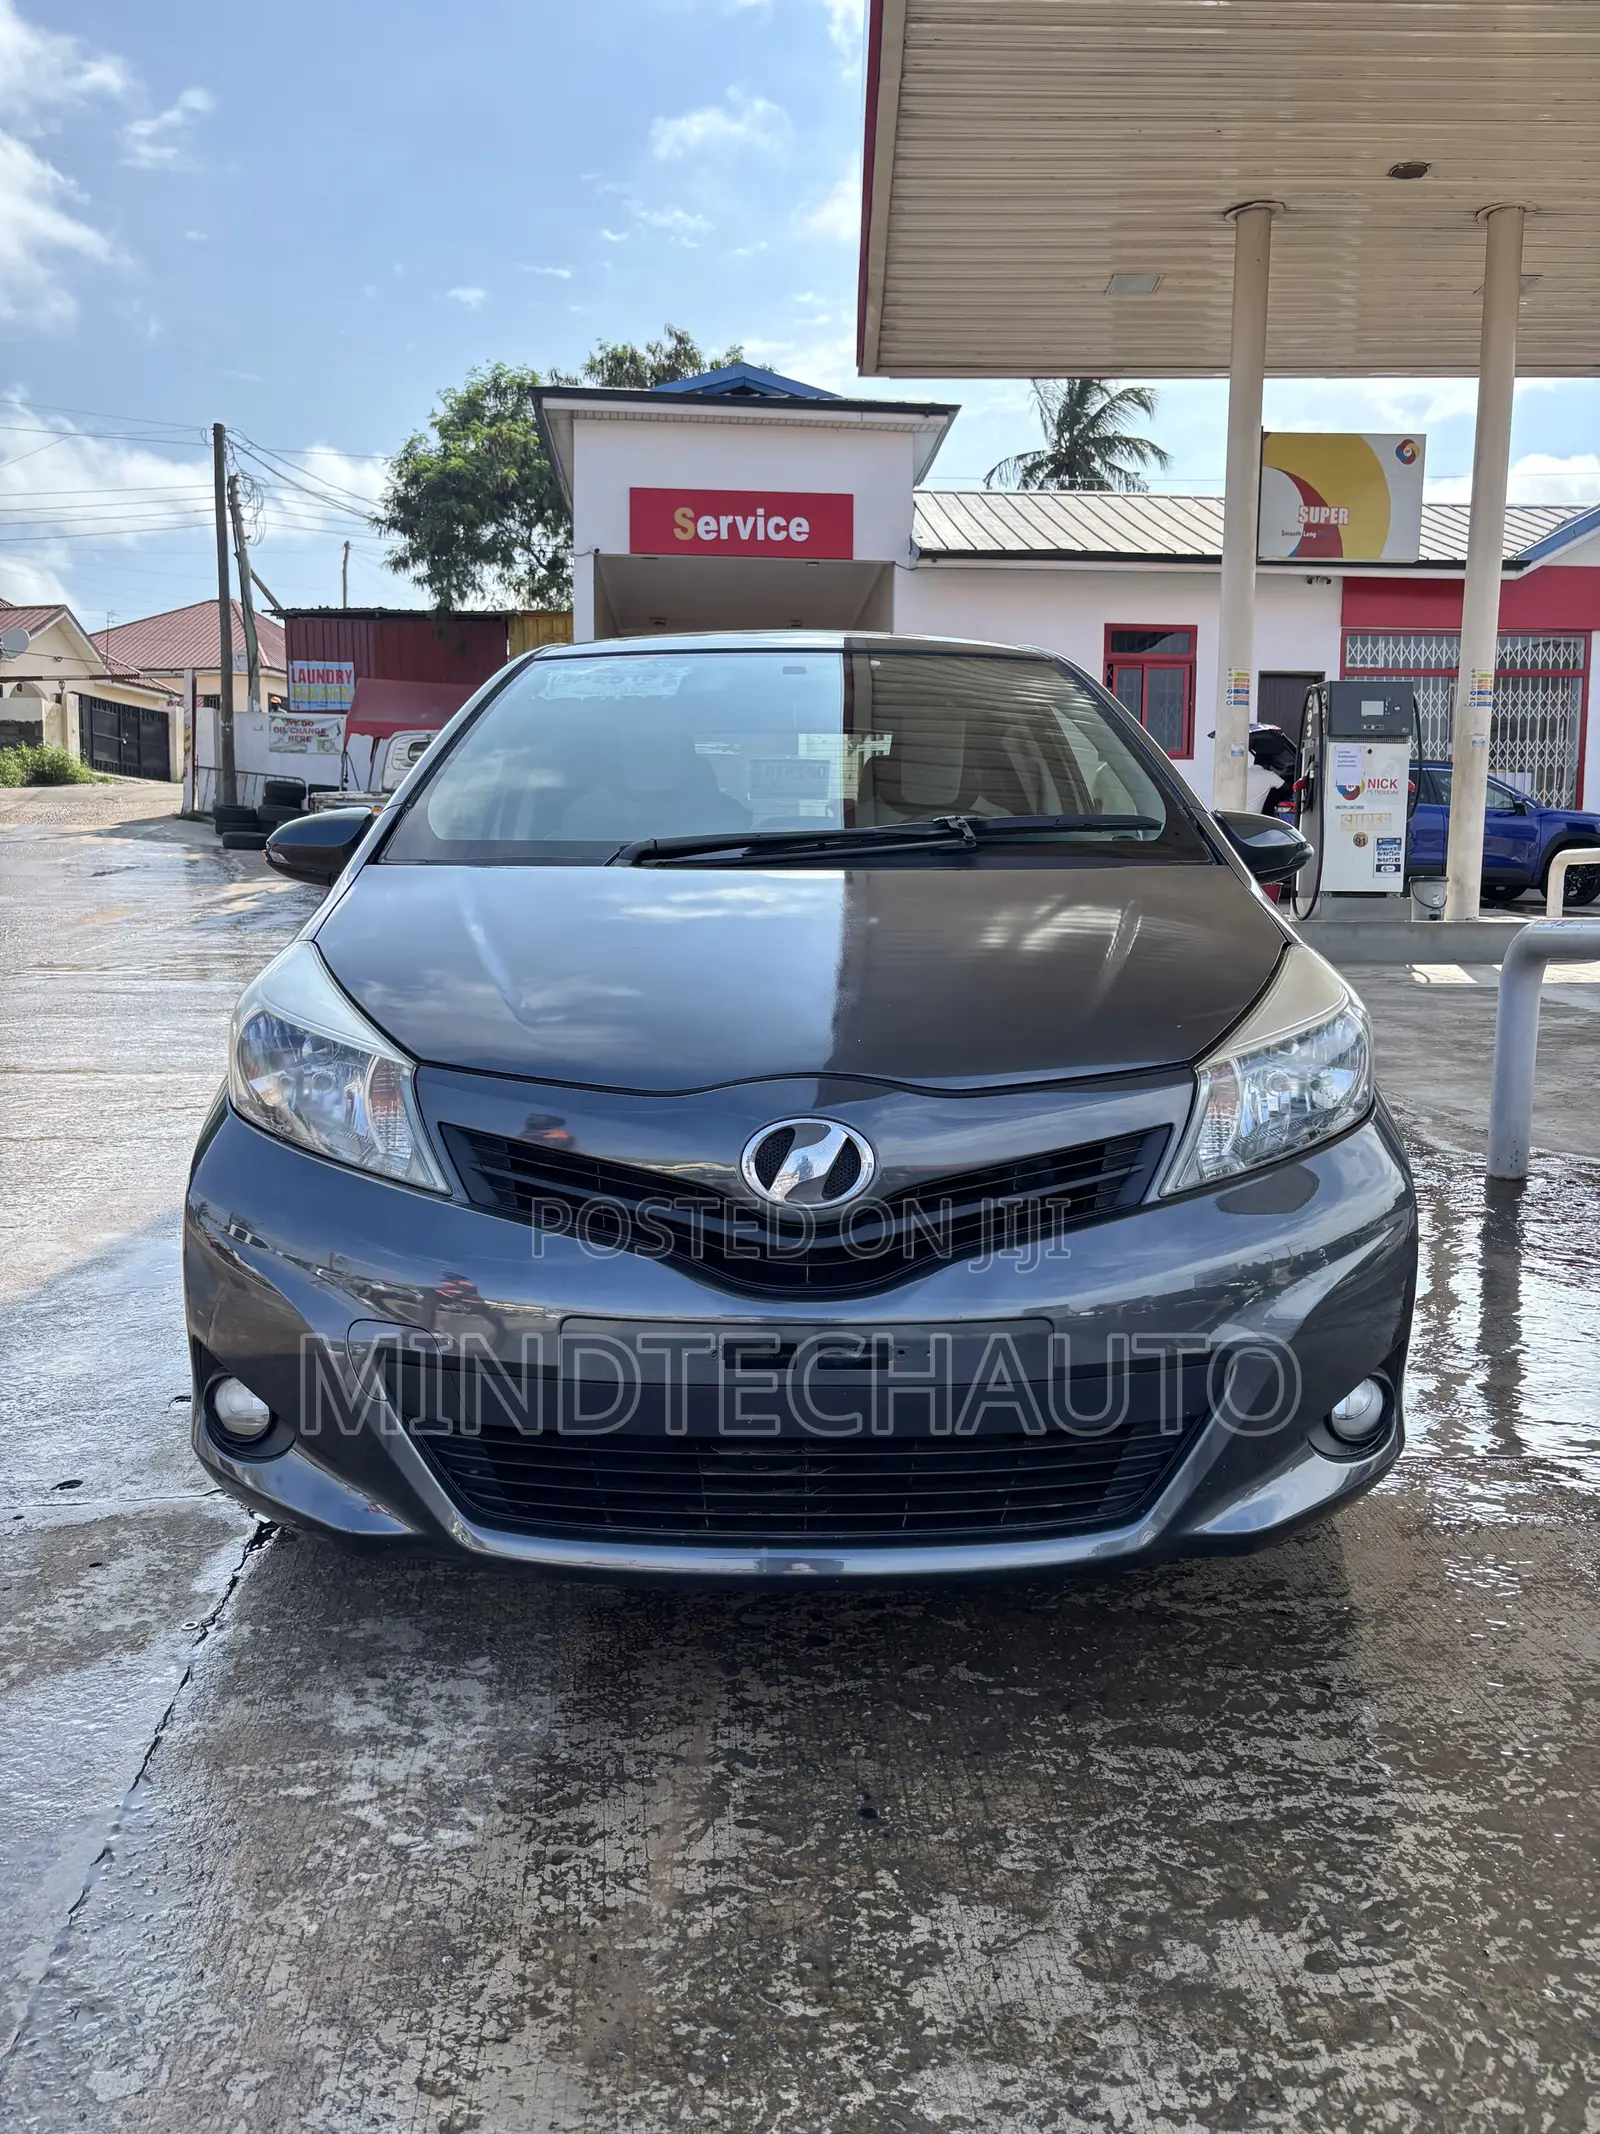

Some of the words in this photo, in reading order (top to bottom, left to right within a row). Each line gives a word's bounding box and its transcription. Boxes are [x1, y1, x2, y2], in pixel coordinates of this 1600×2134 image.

[1299, 506, 1349, 525] SUPER
[673, 507, 810, 542] Service
[291, 668, 353, 685] LAUNDRY
[273, 726, 287, 734] OIL
[289, 727, 327, 735] CHANGE
[288, 735, 312, 743] HERE
[1367, 778, 1398, 789] NICK
[1354, 837, 1366, 846] 91
